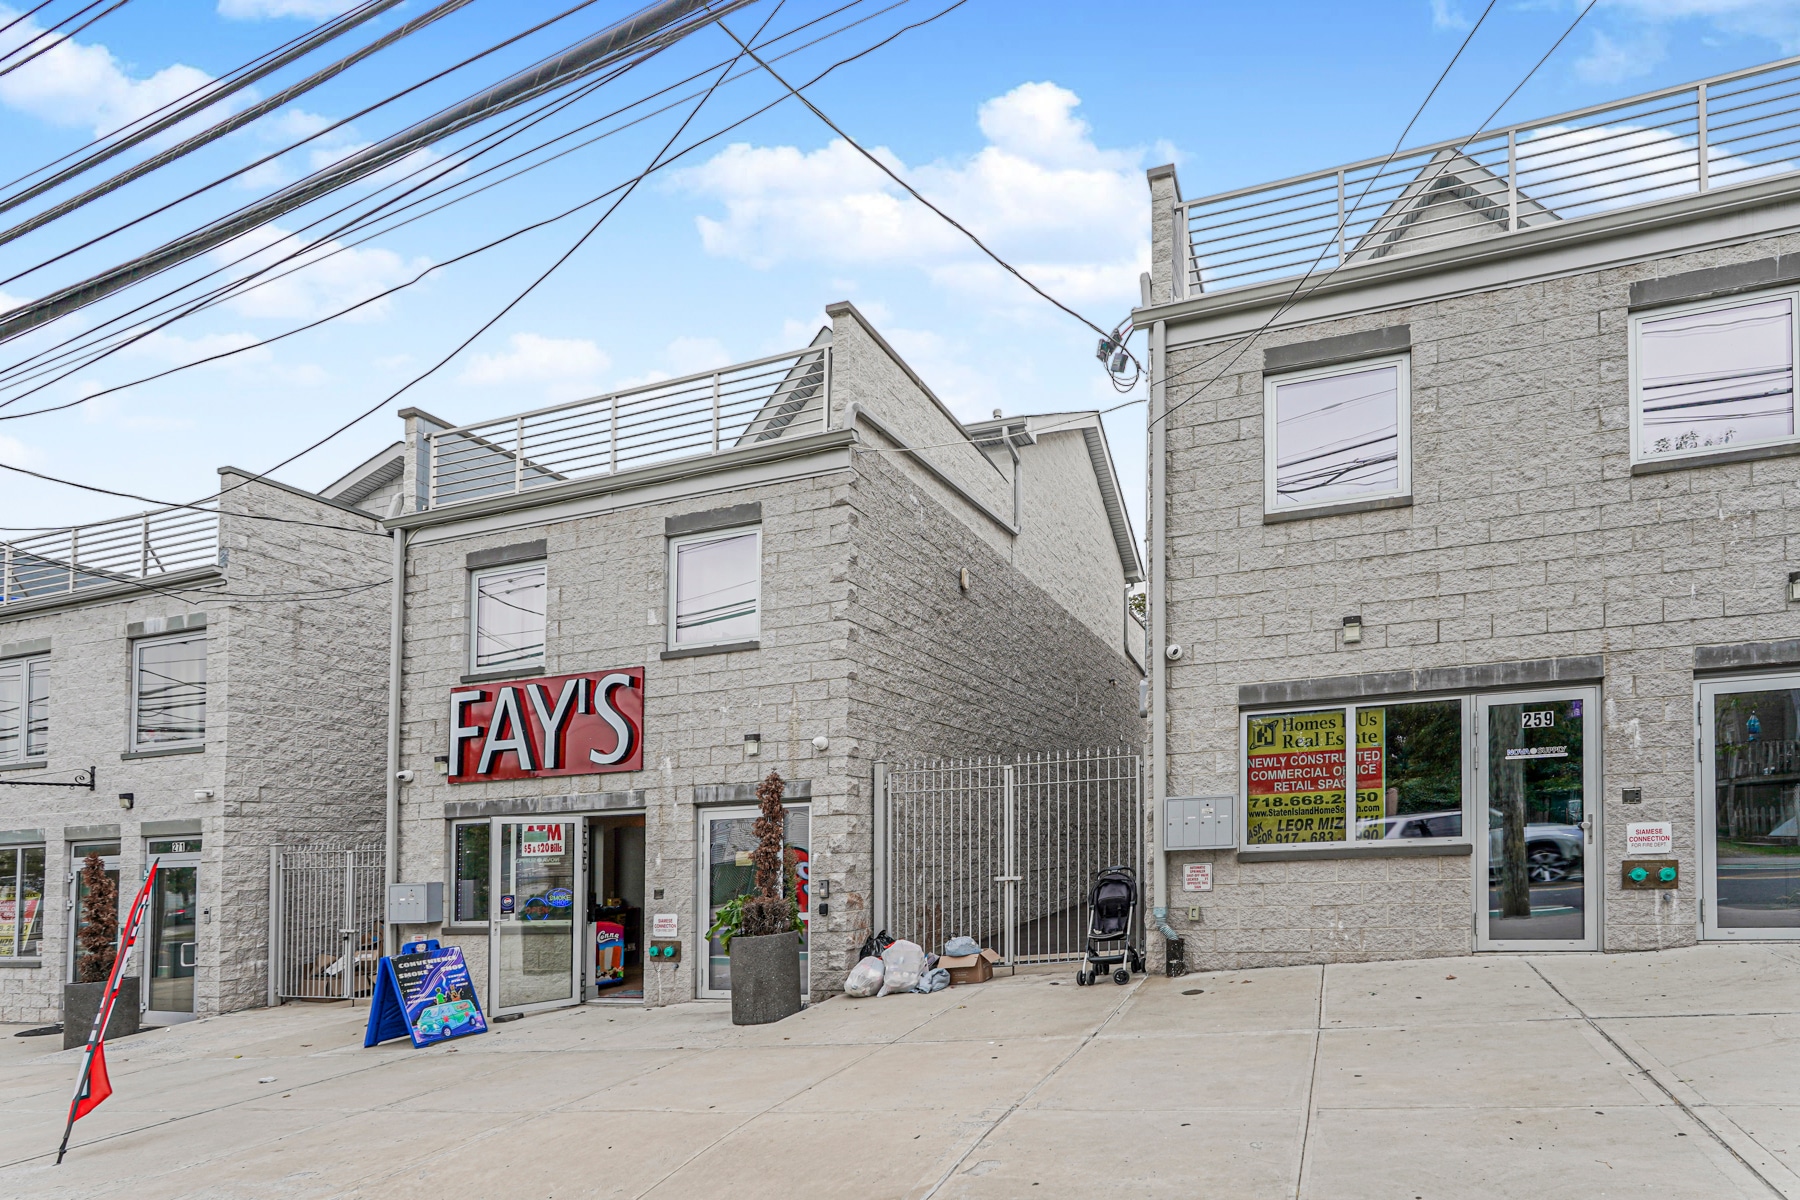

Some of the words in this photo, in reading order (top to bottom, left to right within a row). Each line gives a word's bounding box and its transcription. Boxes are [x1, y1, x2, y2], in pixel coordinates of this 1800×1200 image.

[448, 673, 634, 776] FAY'S
[1282, 717, 1336, 732] Homes
[1357, 711, 1377, 727] Us
[1523, 712, 1553, 727] 259
[1282, 731, 1319, 749] Real
[1325, 731, 1378, 747] Este
[1537, 746, 1567, 754] SUPPLY
[1248, 757, 1287, 769] NEWLY
[1290, 750, 1380, 766] CONSTRUTED
[1251, 768, 1329, 781] COMMERCIAL
[1333, 764, 1377, 777] OFICE
[1274, 781, 1314, 792] RETAIL
[1318, 779, 1348, 789] SPAC
[1249, 792, 1378, 808] 718.668.250
[1249, 804, 1380, 818] www.StatenIslandHomeSeh.com
[1248, 822, 1263, 840] ASK
[1277, 818, 1314, 832] LEOR
[1257, 829, 1273, 844] FOR
[1275, 832, 1299, 843] 917
[1311, 831, 1334, 843] 683
[172, 842, 184, 852] 271
[524, 843, 531, 853] $5
[537, 843, 549, 853] $20
[550, 843, 562, 852] Bills
[525, 906, 549, 914] OPEN
[398, 955, 458, 969] CONVENIENCE
[398, 969, 429, 979] SMOKE
[441, 963, 464, 973] SHOP
